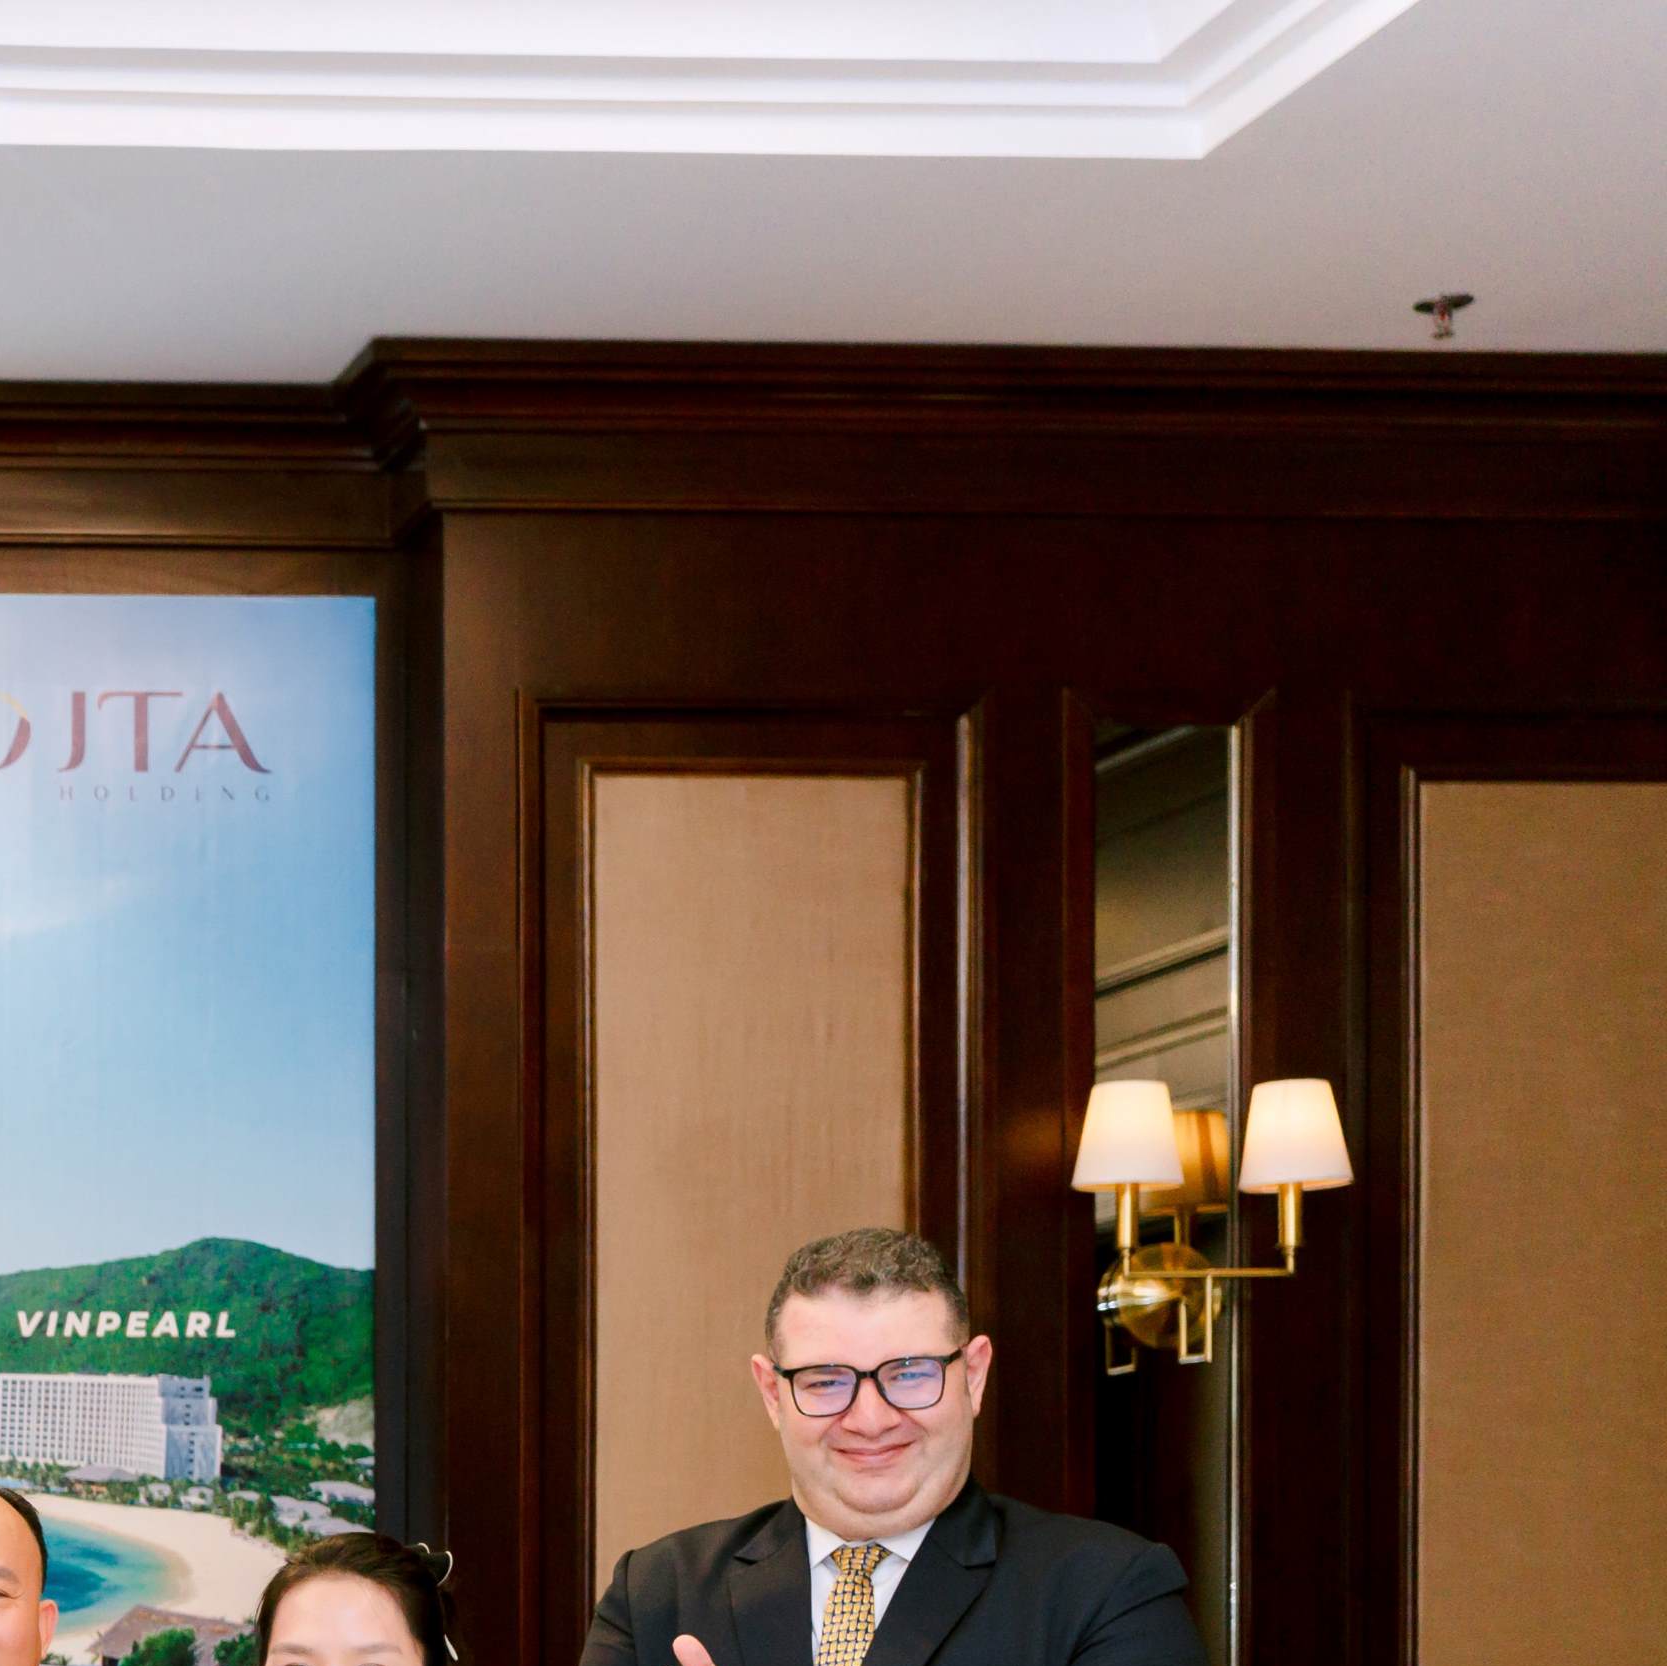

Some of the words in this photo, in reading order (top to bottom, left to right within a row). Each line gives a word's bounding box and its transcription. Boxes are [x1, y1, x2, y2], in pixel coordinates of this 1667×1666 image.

[56, 690, 273, 774] JTA
[58, 784, 272, 804] HOLDING
[16, 1309, 237, 1339] VINPEARL
